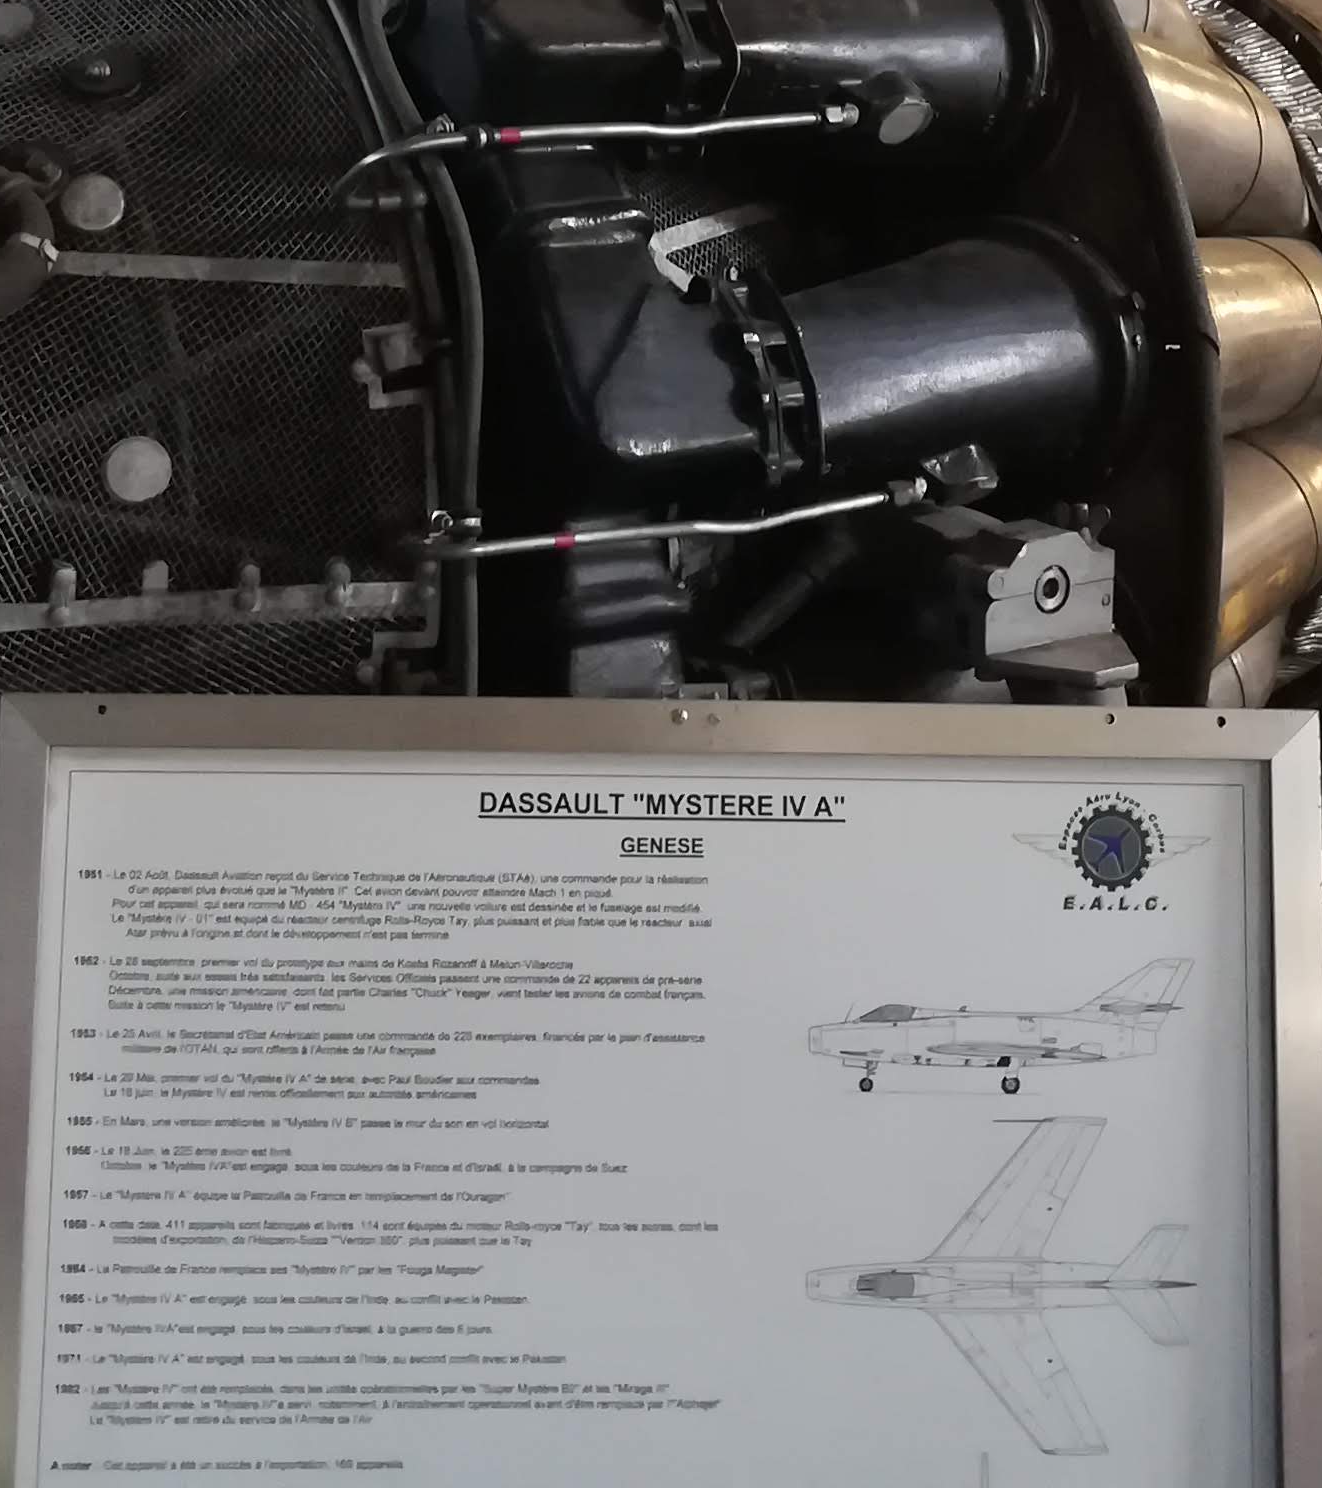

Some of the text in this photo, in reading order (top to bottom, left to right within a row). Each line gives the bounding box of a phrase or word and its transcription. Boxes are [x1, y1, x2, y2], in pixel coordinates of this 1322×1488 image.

[480, 792, 846, 817] DASSAULT "MYSTERE IV A"
[620, 837, 705, 854] GENESE
